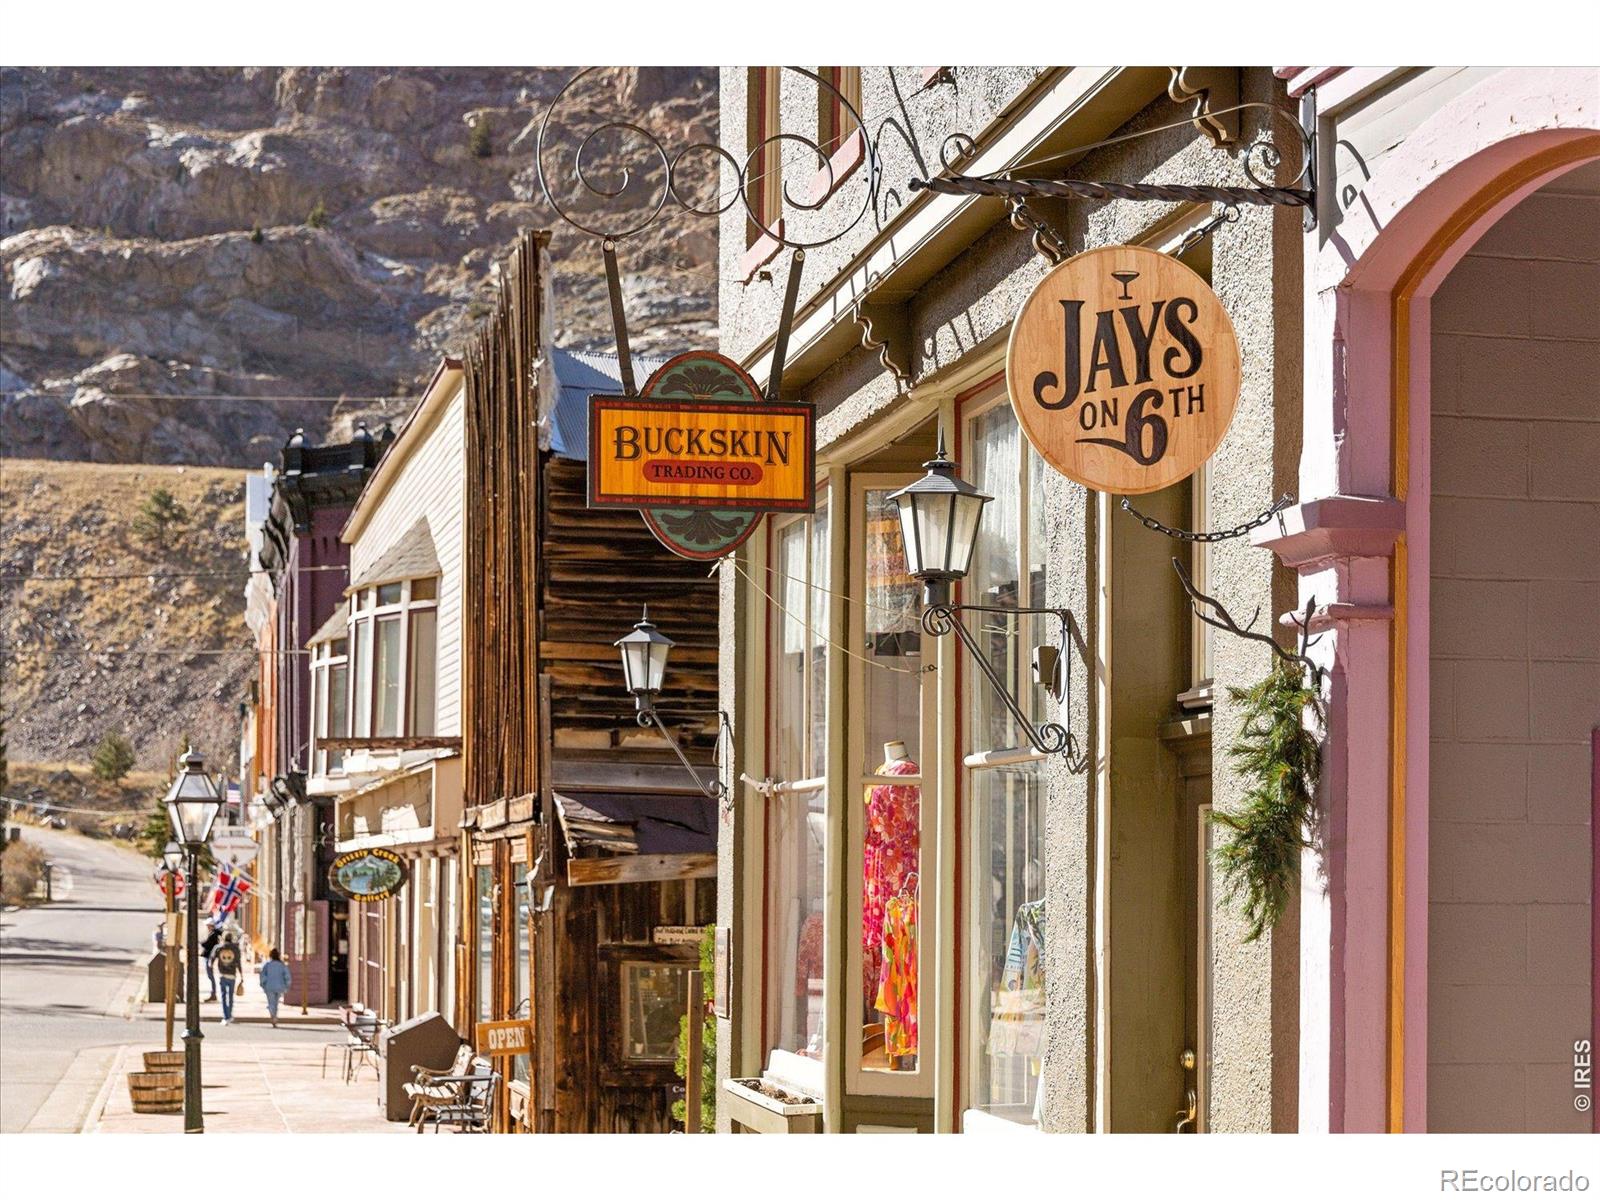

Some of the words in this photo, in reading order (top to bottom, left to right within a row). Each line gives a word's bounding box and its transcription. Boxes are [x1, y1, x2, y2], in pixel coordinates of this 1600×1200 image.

[1033, 296, 1203, 411] JAYS
[1075, 384, 1205, 466] 6TH
[1079, 398, 1118, 430] ON
[613, 425, 792, 466] BUCKSKIN
[652, 464, 725, 479] TRADING
[729, 467, 755, 480] CO.
[488, 1027, 525, 1050] OPEN
